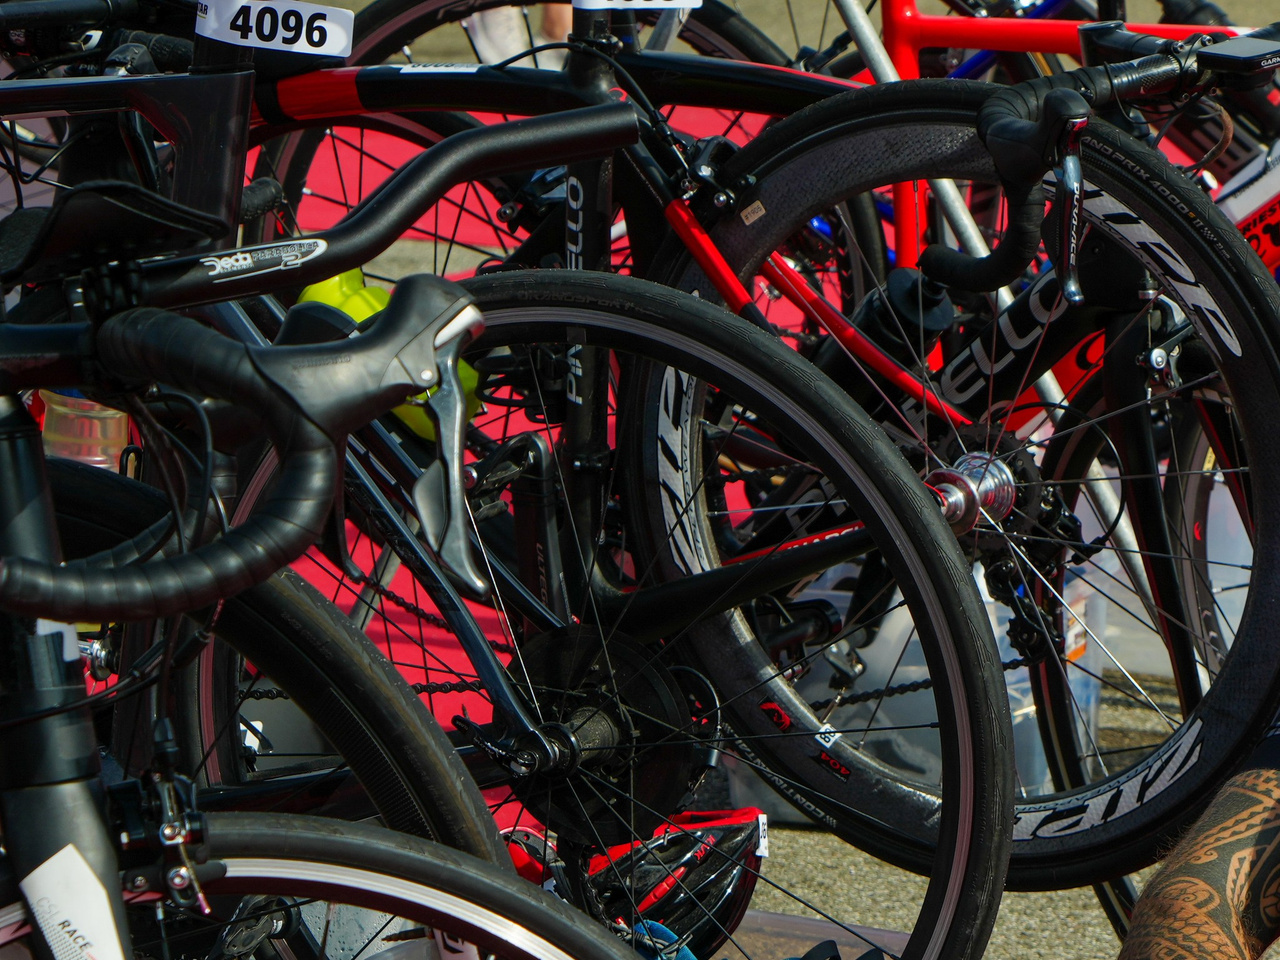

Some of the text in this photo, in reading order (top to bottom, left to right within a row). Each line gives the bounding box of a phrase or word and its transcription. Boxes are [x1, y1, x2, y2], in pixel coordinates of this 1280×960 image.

[229, 5, 328, 48] 4096
[1081, 135, 1112, 155] AND
[1111, 150, 1149, 180] PRIX
[1070, 181, 1080, 266] DURA-ACE
[657, 364, 703, 577] ZIP
[536, 542, 549, 607] ULTEG
[820, 751, 850, 776] 404
[58, 919, 94, 953] RACE
